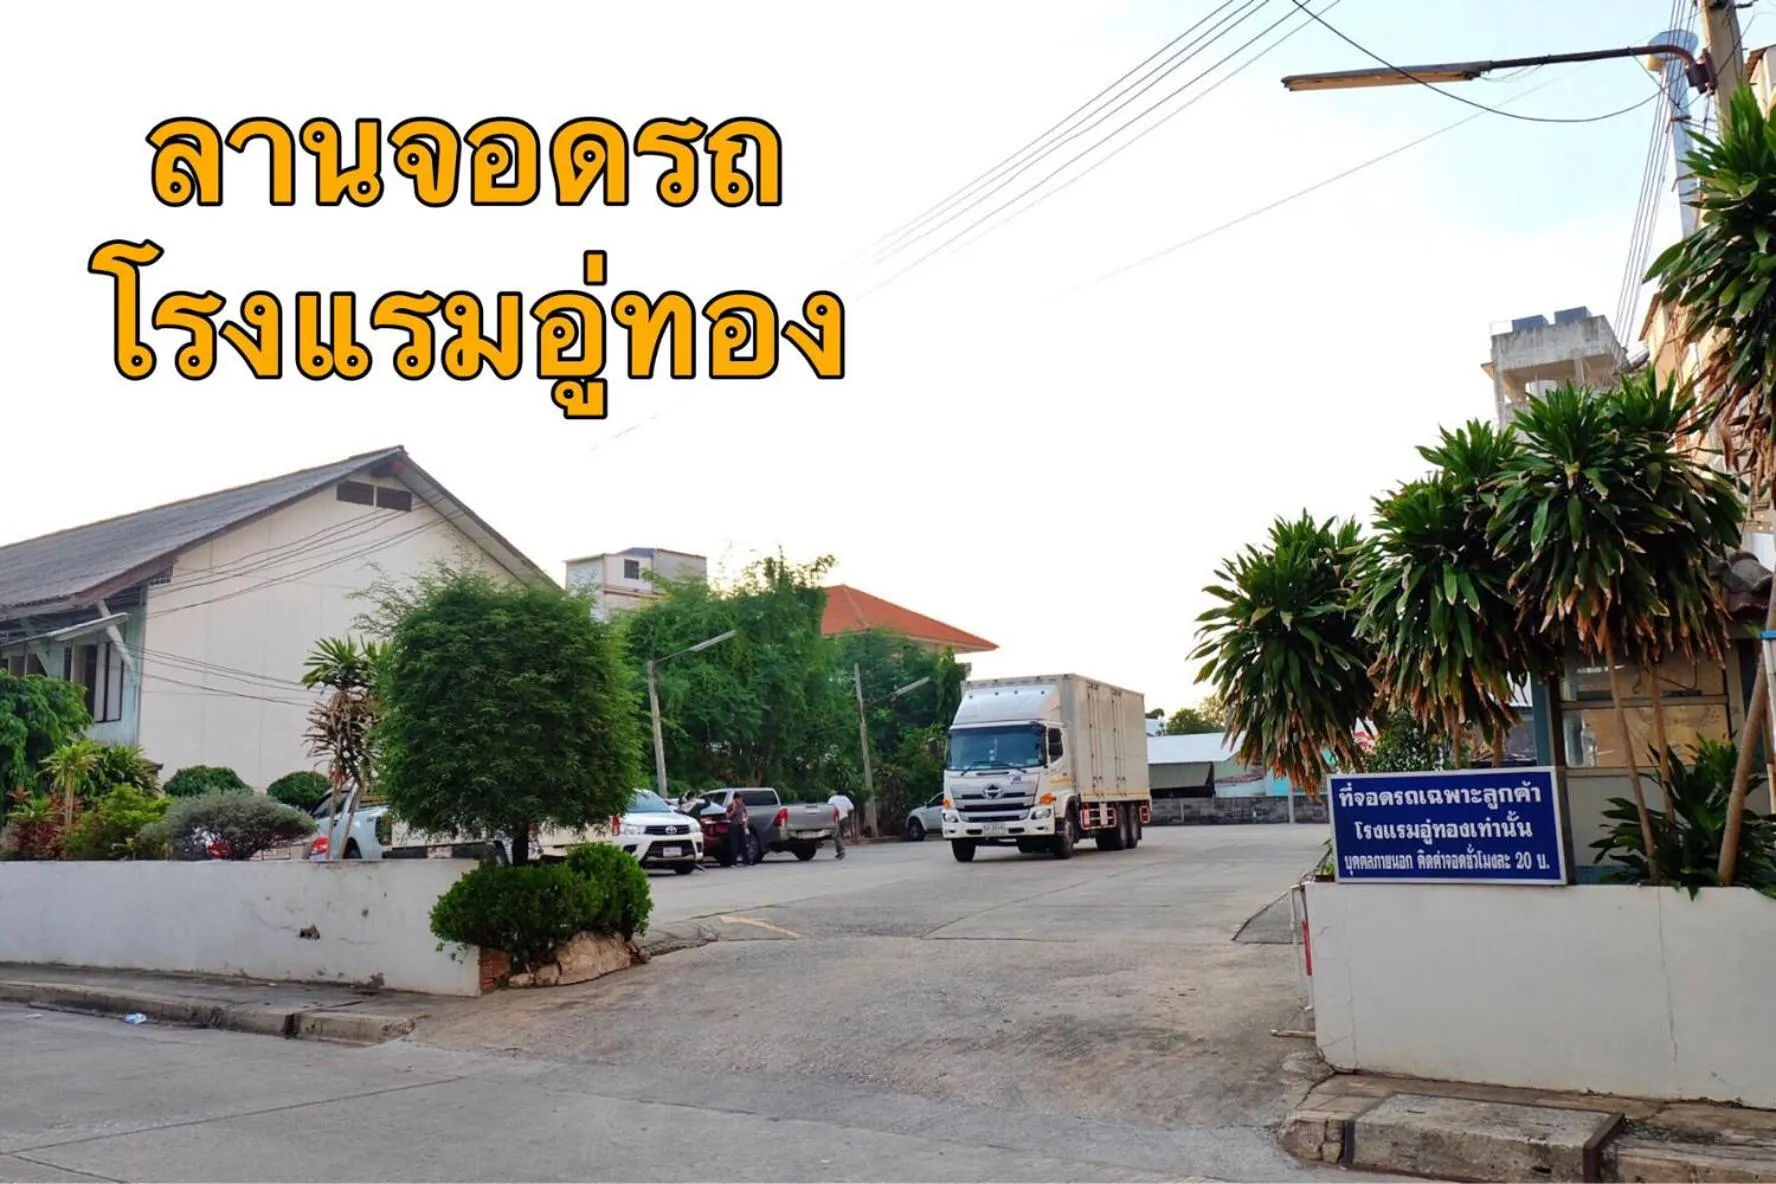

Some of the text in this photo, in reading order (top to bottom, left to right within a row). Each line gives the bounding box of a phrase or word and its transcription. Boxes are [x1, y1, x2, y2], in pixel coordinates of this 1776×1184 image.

[1338, 781, 1541, 810] ที่จอดรถเฉพาะลูกค้า
[1354, 811, 1533, 845] โรงแรมอู่ทองเท่านั้น
[1515, 851, 1532, 869] 20
